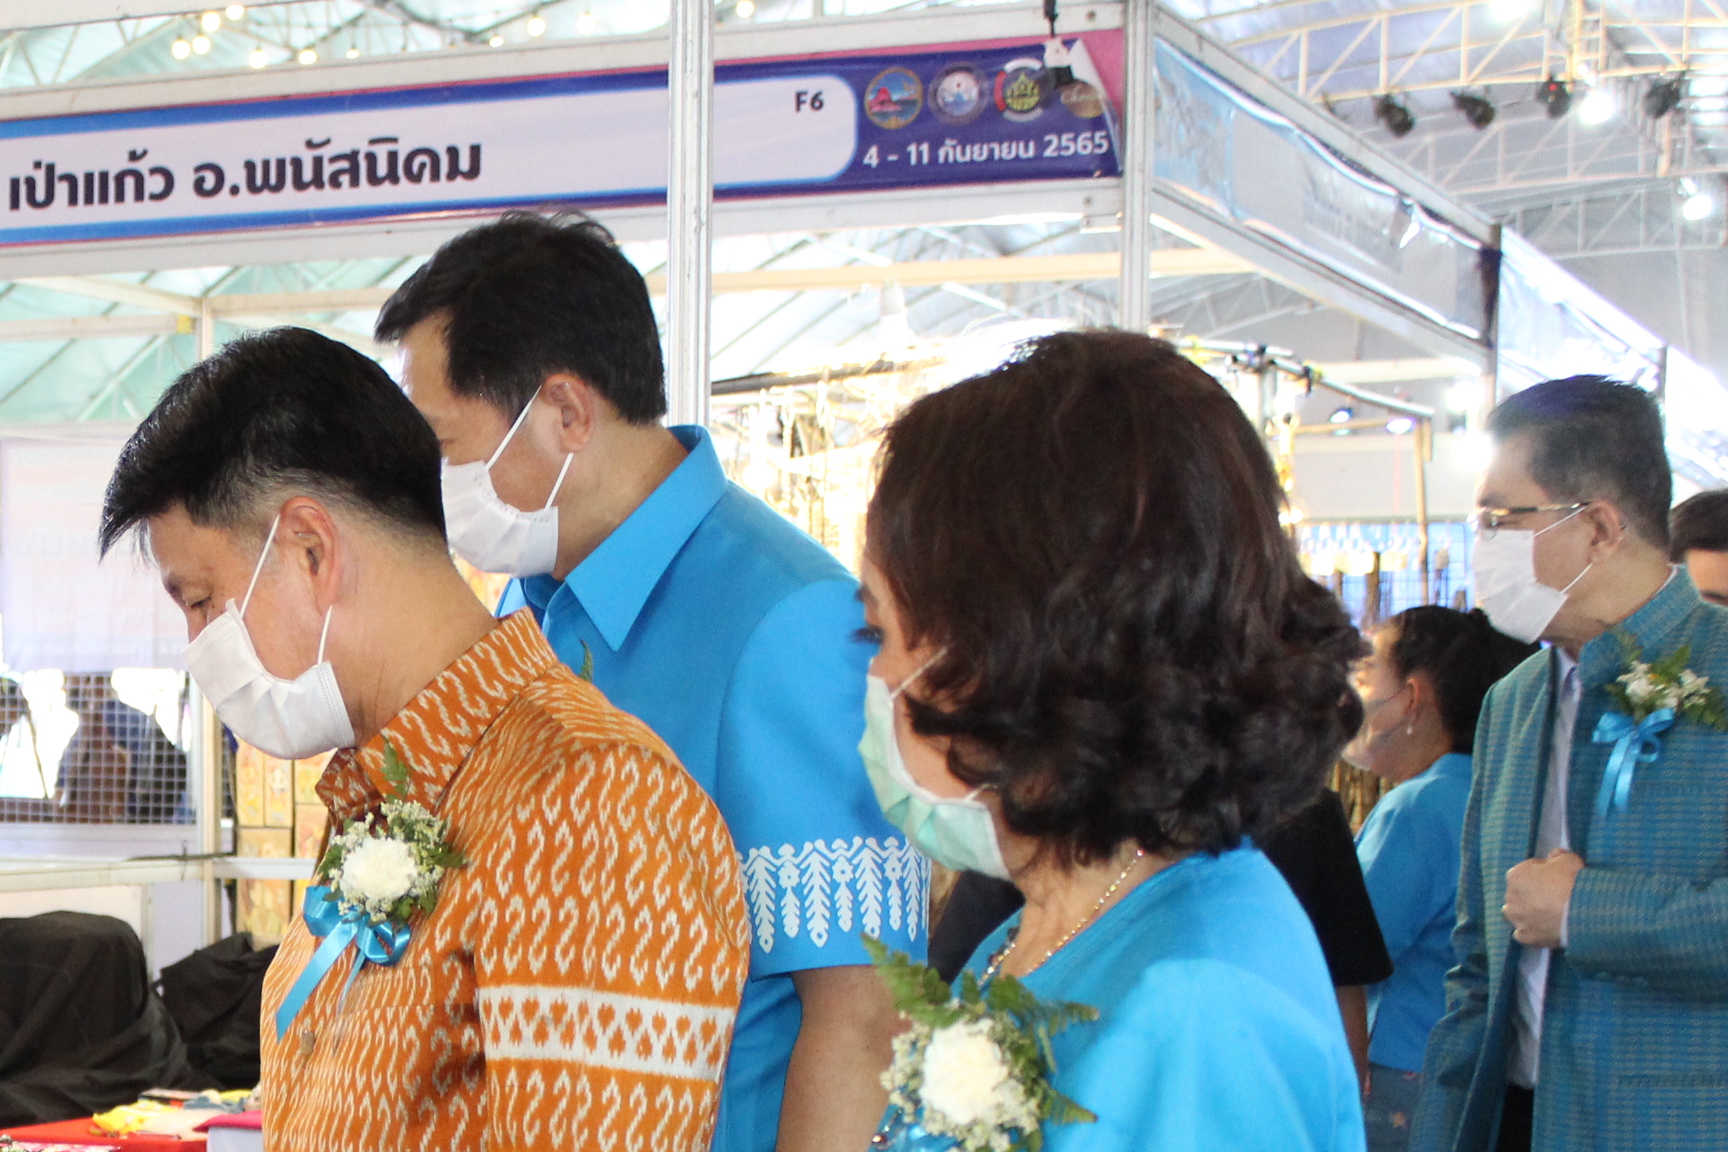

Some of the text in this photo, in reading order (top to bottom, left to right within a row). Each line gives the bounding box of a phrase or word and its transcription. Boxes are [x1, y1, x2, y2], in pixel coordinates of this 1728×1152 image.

[794, 90, 825, 113] F6
[863, 145, 880, 168] 4
[906, 141, 930, 166] 11
[937, 138, 1036, 164] กันยายน
[1043, 130, 1109, 158] 2565
[8, 136, 483, 212] เป่าแก้ว อ.พนัสนิคม
